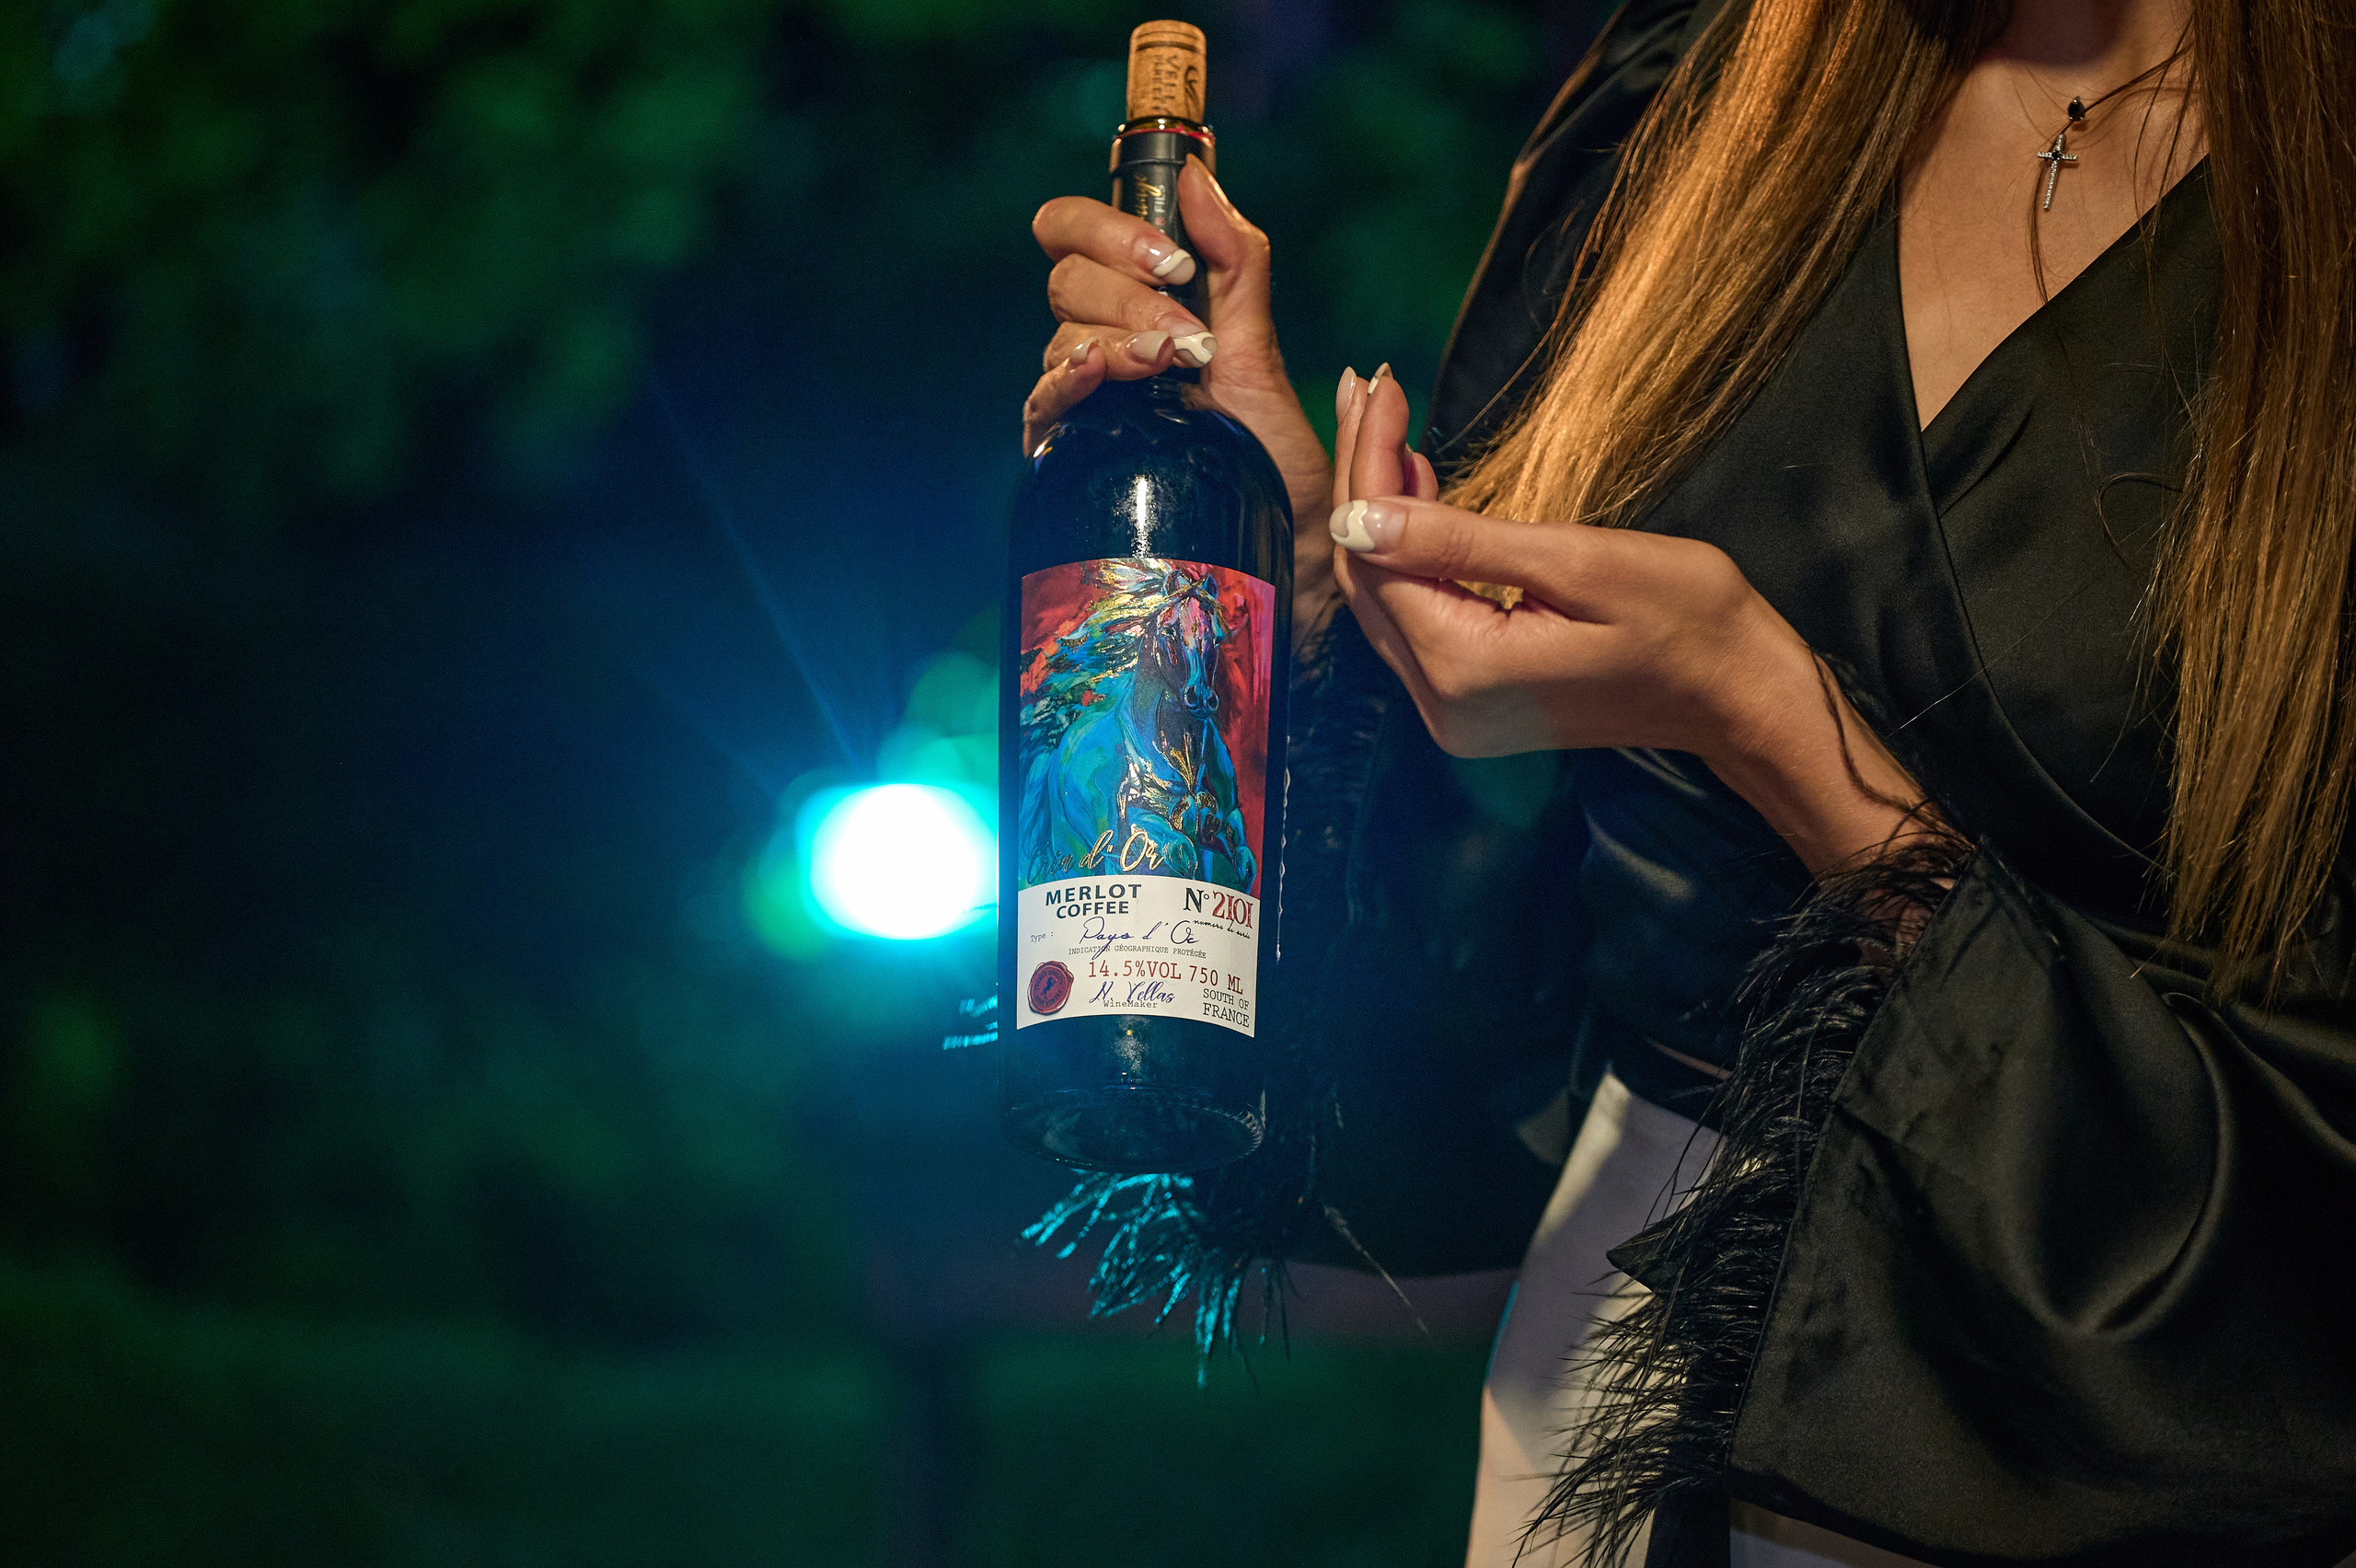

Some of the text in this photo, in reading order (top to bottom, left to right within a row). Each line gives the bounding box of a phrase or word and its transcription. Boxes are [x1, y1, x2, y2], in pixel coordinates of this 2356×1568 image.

[1045, 883, 1141, 906] MERLOT
[1056, 901, 1129, 919] COFFEE
[1030, 931, 1046, 942] Type
[1079, 916, 1134, 960] Pays
[1114, 943, 1169, 955] GÉOGRAPHIQUE
[1172, 948, 1207, 959] PROTÉGÉE
[1189, 964, 1218, 986] 750
[1228, 974, 1243, 995] ML
[1127, 980, 1176, 1004] Vellas
[1203, 988, 1250, 1010] SOUTH OF
[1103, 1000, 1158, 1009] WineMaker
[1203, 1002, 1250, 1028] FRANCE
